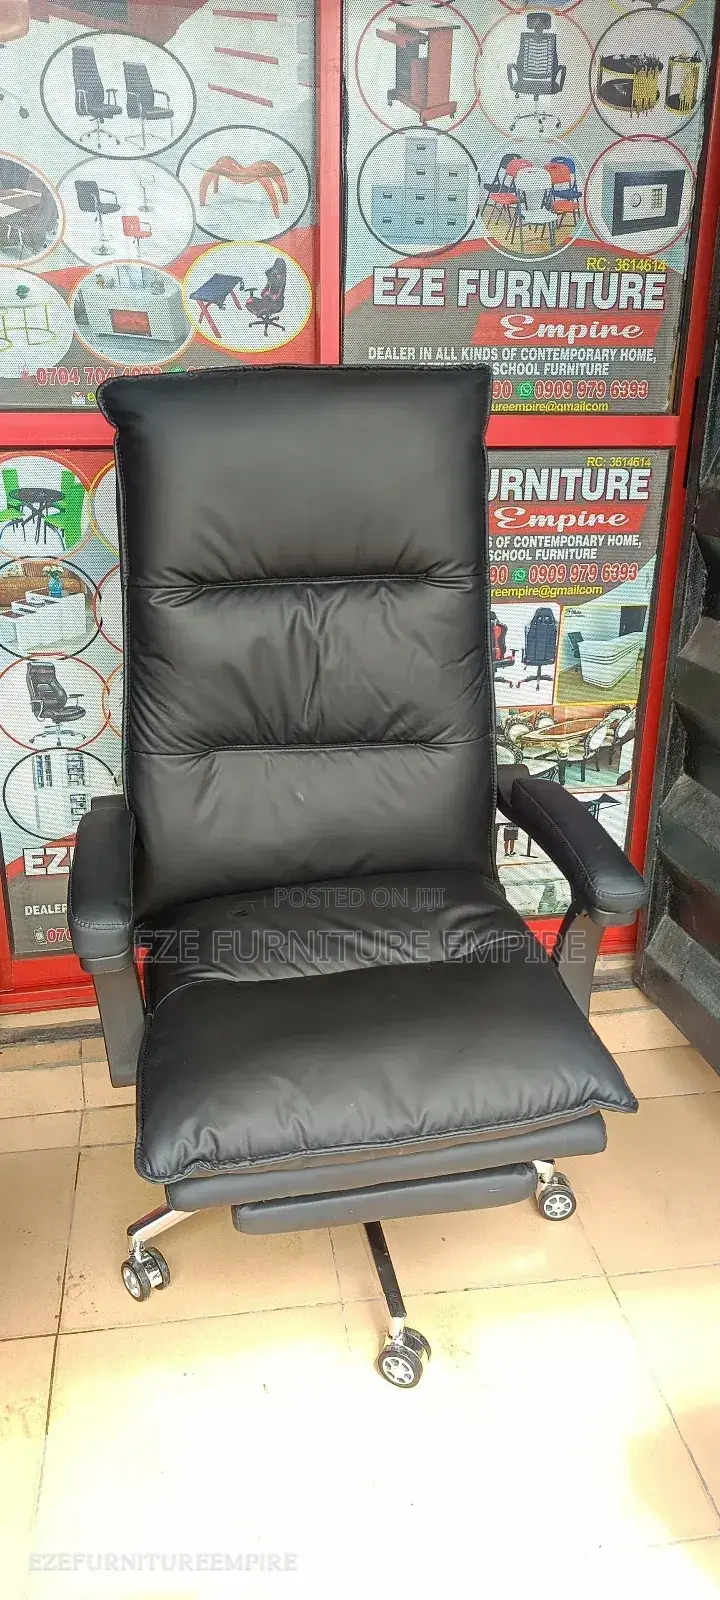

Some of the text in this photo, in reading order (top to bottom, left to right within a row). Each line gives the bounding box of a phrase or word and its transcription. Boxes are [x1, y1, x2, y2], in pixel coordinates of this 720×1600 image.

[615, 257, 667, 272] 3614614
[373, 267, 667, 310] EZE FURNITURE
[500, 313, 643, 345] Empire
[368, 346, 657, 363] DEALER IN ALL KINDS OF CONTEMPORARY HOME,
[492, 362, 610, 376] SCHOOL FURNITURE
[534, 379, 573, 399] 0909
[576, 379, 607, 399] 979
[610, 379, 649, 399] 6393
[609, 456, 652, 467] 3614614
[493, 506, 630, 533] Empire
[496, 536, 511, 548] OF
[513, 535, 604, 548] CONTEMPORARY
[607, 534, 642, 548] HOME,
[489, 548, 598, 562] SCHOOL FURNITURE
[528, 564, 566, 584] 0909
[569, 564, 598, 583] 979
[601, 562, 639, 583] 6393
